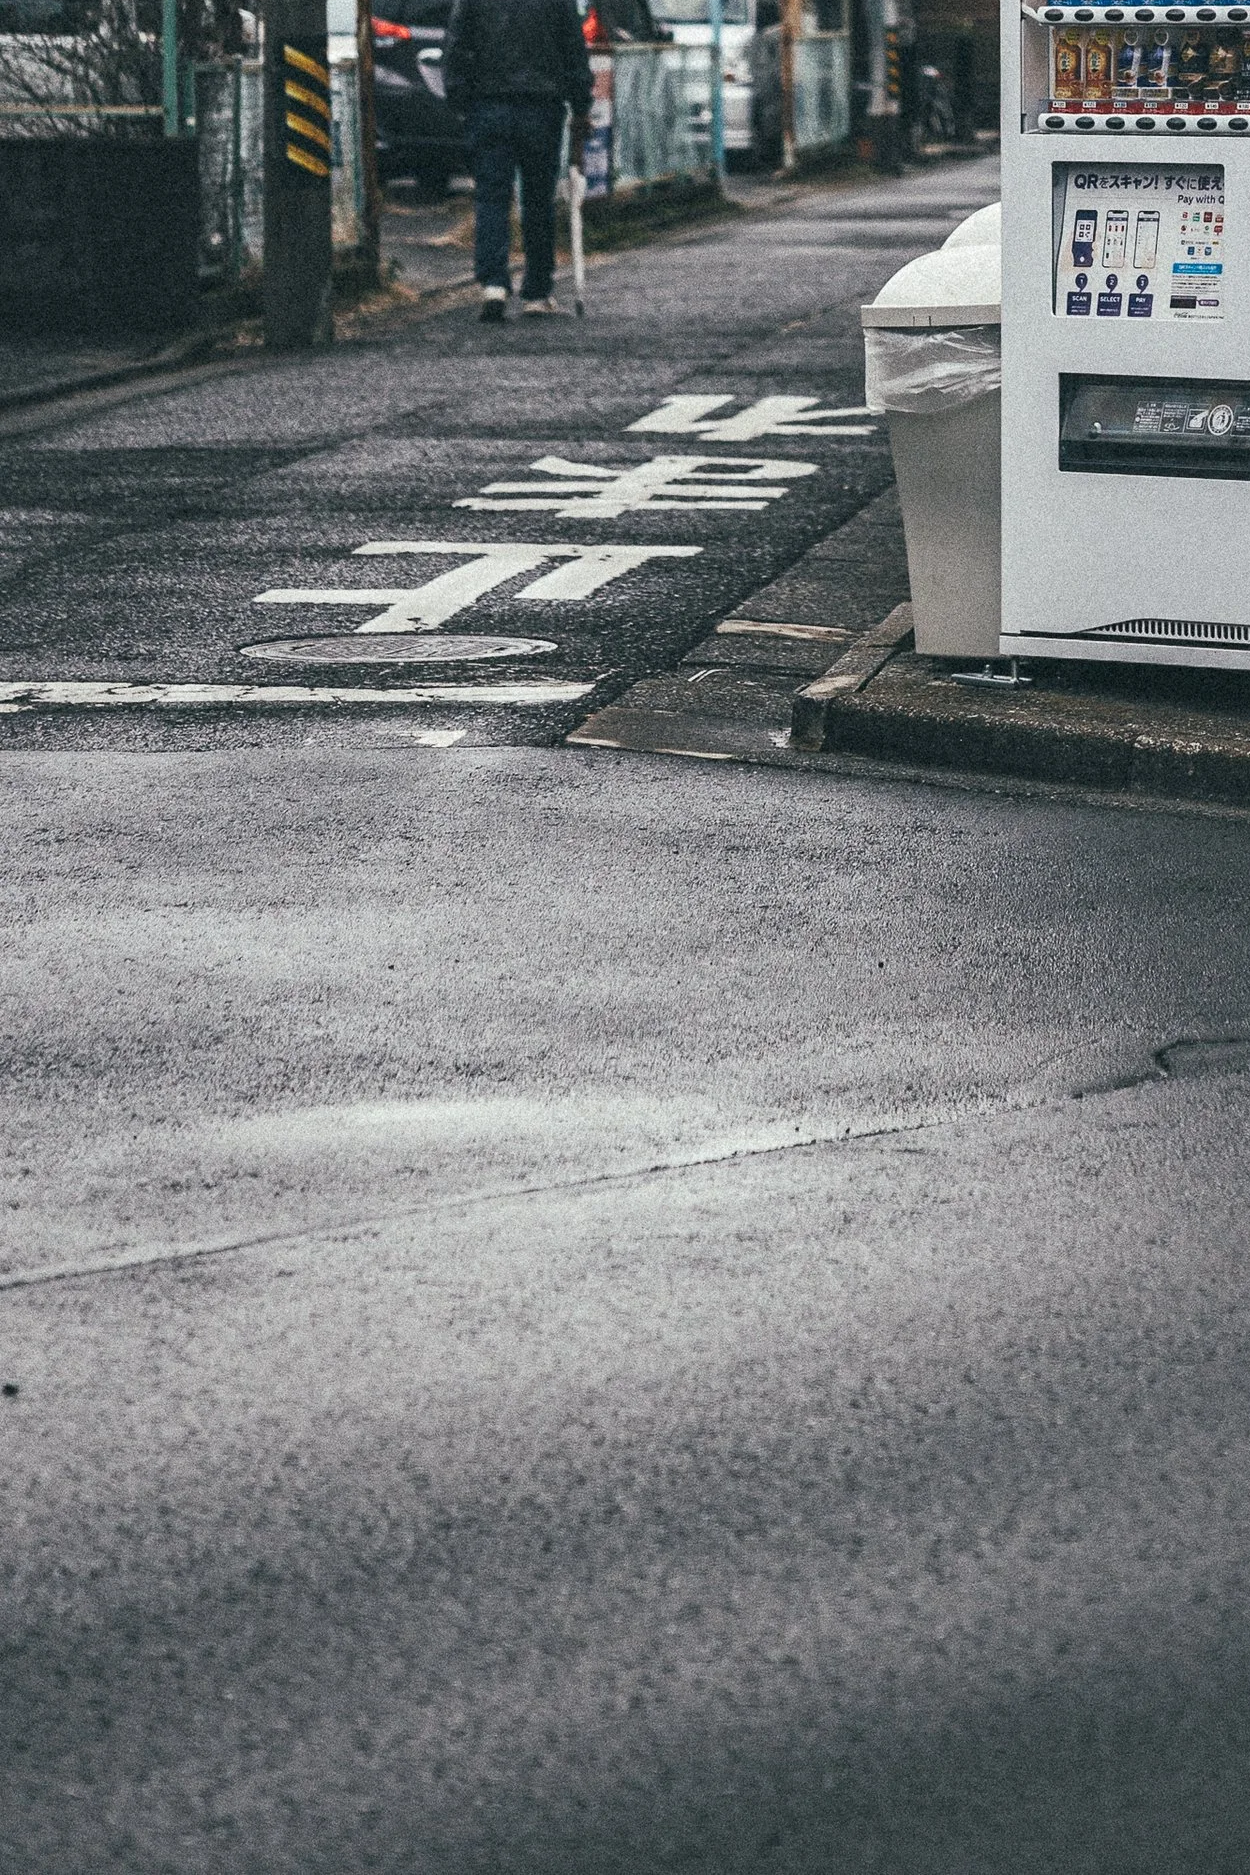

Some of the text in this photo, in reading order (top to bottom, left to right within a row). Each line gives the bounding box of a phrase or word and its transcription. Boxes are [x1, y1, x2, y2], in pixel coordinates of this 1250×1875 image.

[1074, 174, 1225, 191] QRをスキャン! すぐに使え
[1177, 195, 1194, 205] Pay
[1195, 195, 1215, 204] with
